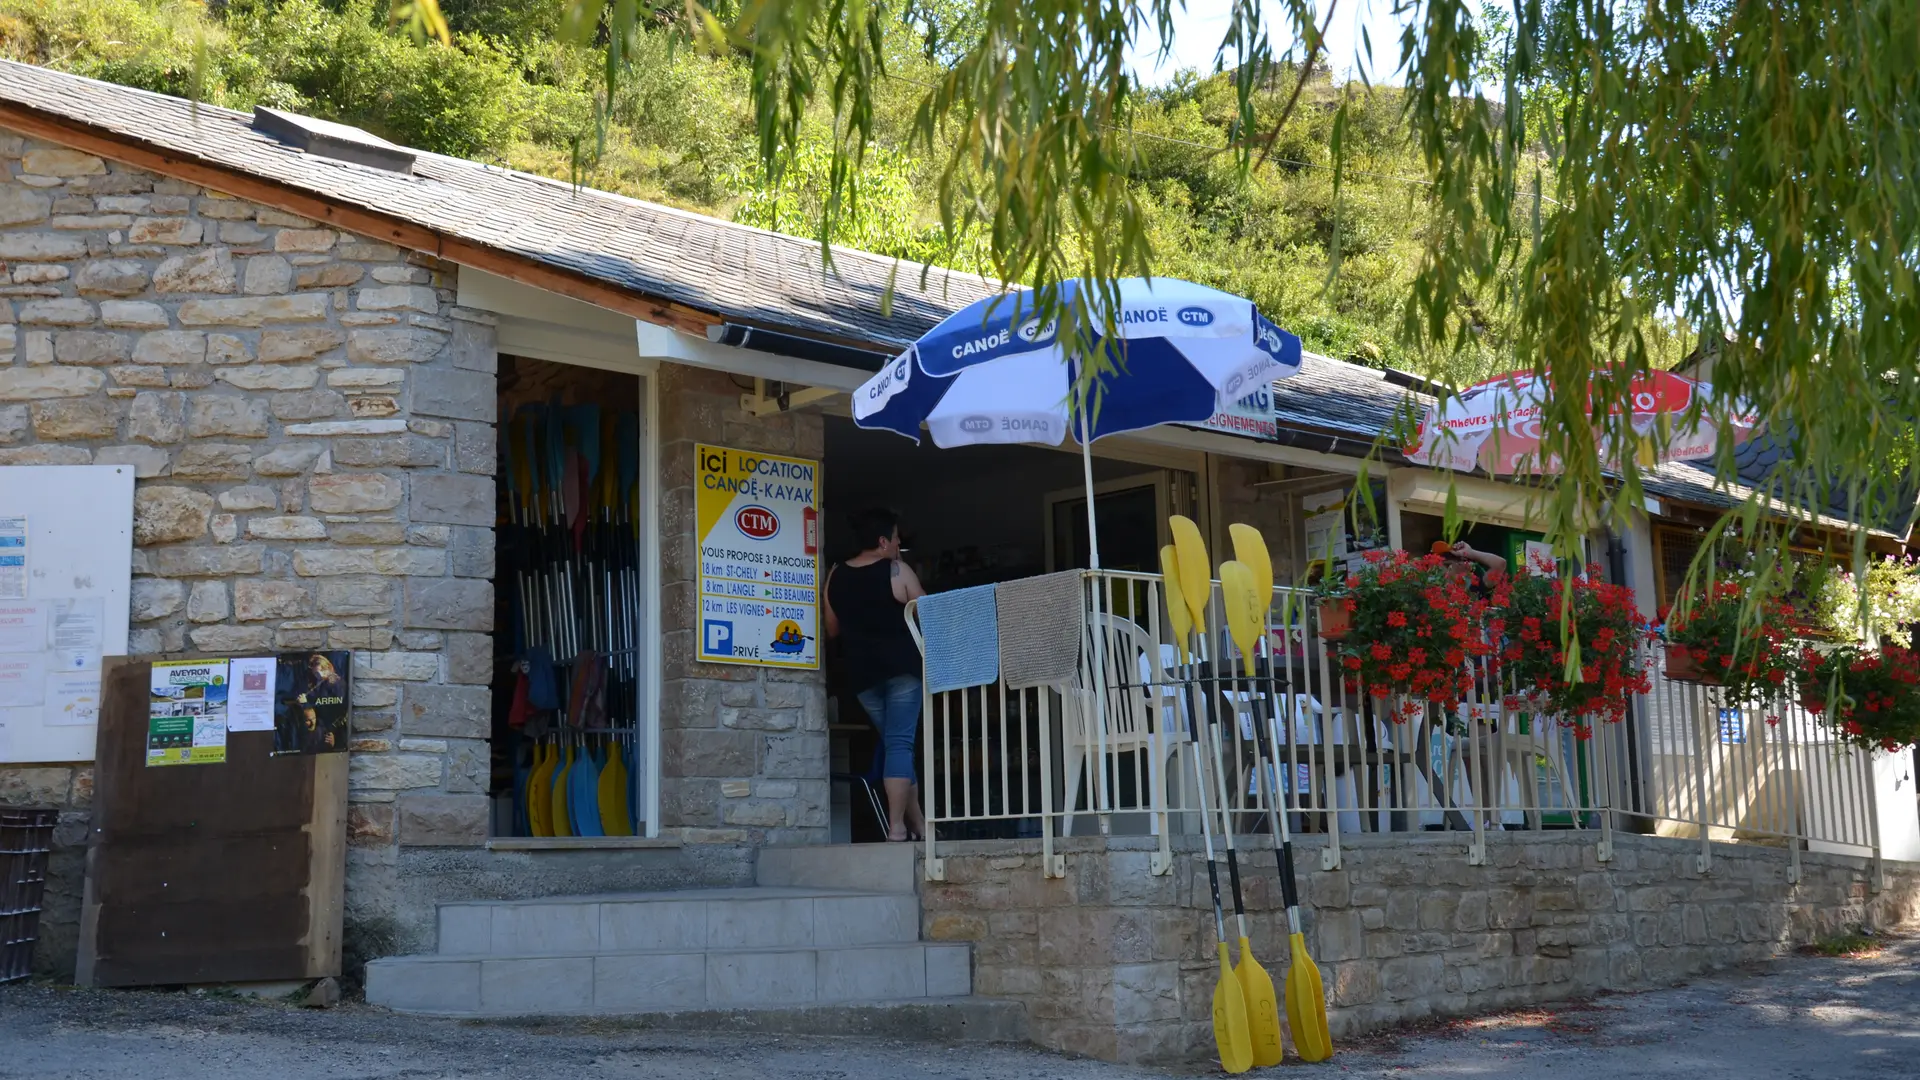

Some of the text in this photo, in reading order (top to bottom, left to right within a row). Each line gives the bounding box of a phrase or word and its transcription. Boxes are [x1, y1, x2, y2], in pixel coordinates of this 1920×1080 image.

[1181, 311, 1210, 323] CTM
[952, 328, 1010, 359] CANOË
[739, 456, 813, 482] LOCATION
[704, 474, 813, 503] CANOË-KAYAK
[741, 512, 773, 531] CTM
[701, 546, 816, 569] VOUS PROPOSE 3 PARCOURS
[702, 562, 814, 586] 18 km ST-CHELY LES BEAUMES
[706, 580, 815, 603] 8 km L'ANGLE LES BEAUMES
[702, 600, 805, 620] 12 km LES VIGNES LE ROZIER
[708, 624, 729, 650] P
[733, 645, 759, 658] PRIVÉ
[170, 668, 210, 677] AVEYRON
